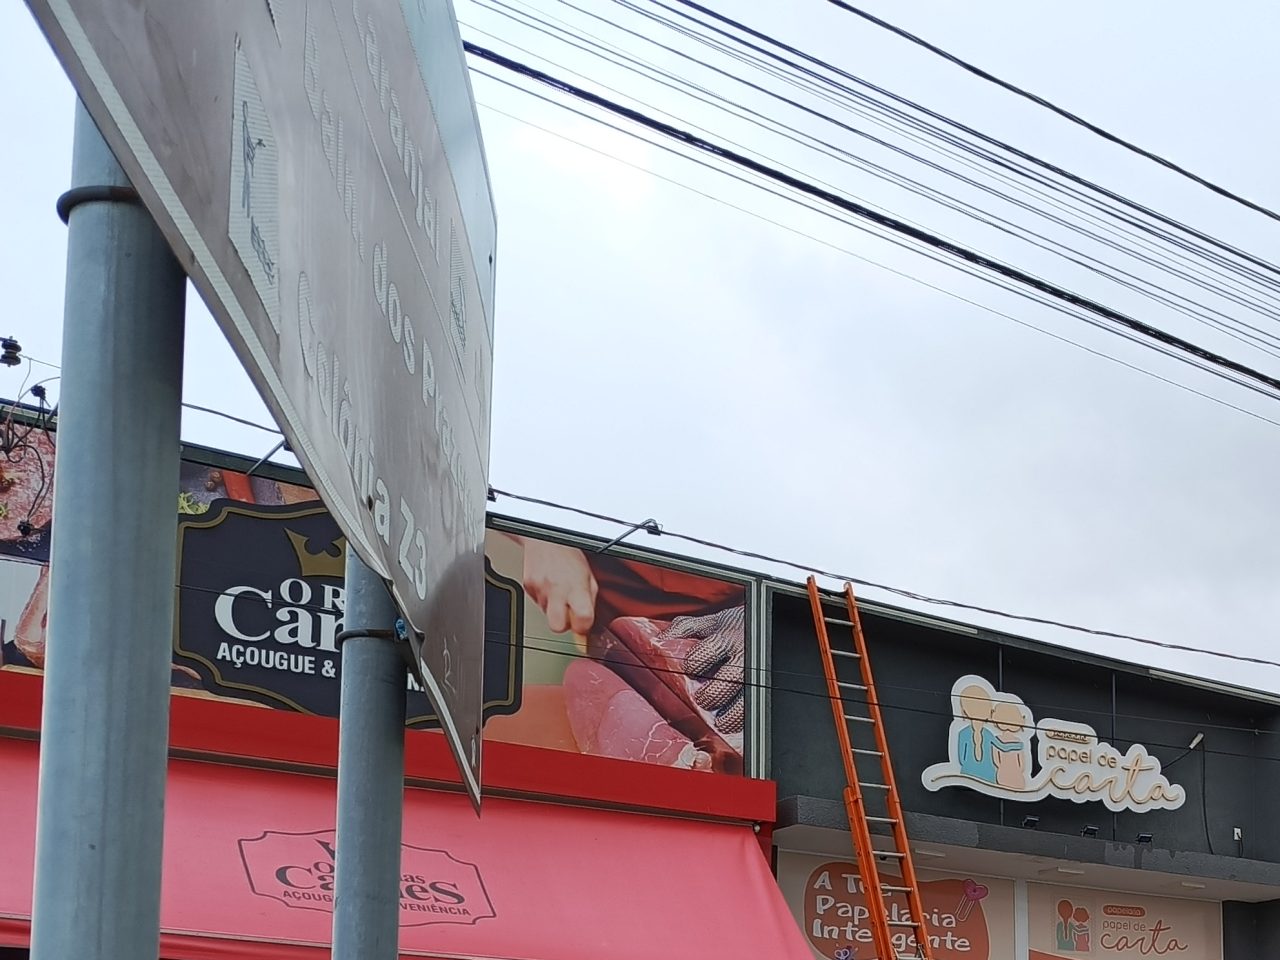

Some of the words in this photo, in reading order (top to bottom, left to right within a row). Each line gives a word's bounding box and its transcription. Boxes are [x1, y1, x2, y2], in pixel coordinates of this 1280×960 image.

[372, 240, 416, 375] dos
[297, 271, 391, 546] Colônia
[399, 495, 429, 601] Z3
[279, 578, 312, 605] O
[216, 642, 316, 675] AÇOUGUE
[321, 659, 336, 678] &
[1046, 745, 1092, 766] papel
[1100, 754, 1118, 769] de
[1049, 752, 1183, 805] carta
[813, 870, 833, 890] A
[1100, 918, 1189, 956] carta
[1102, 919, 1131, 933] papel
[1133, 920, 1147, 932] de
